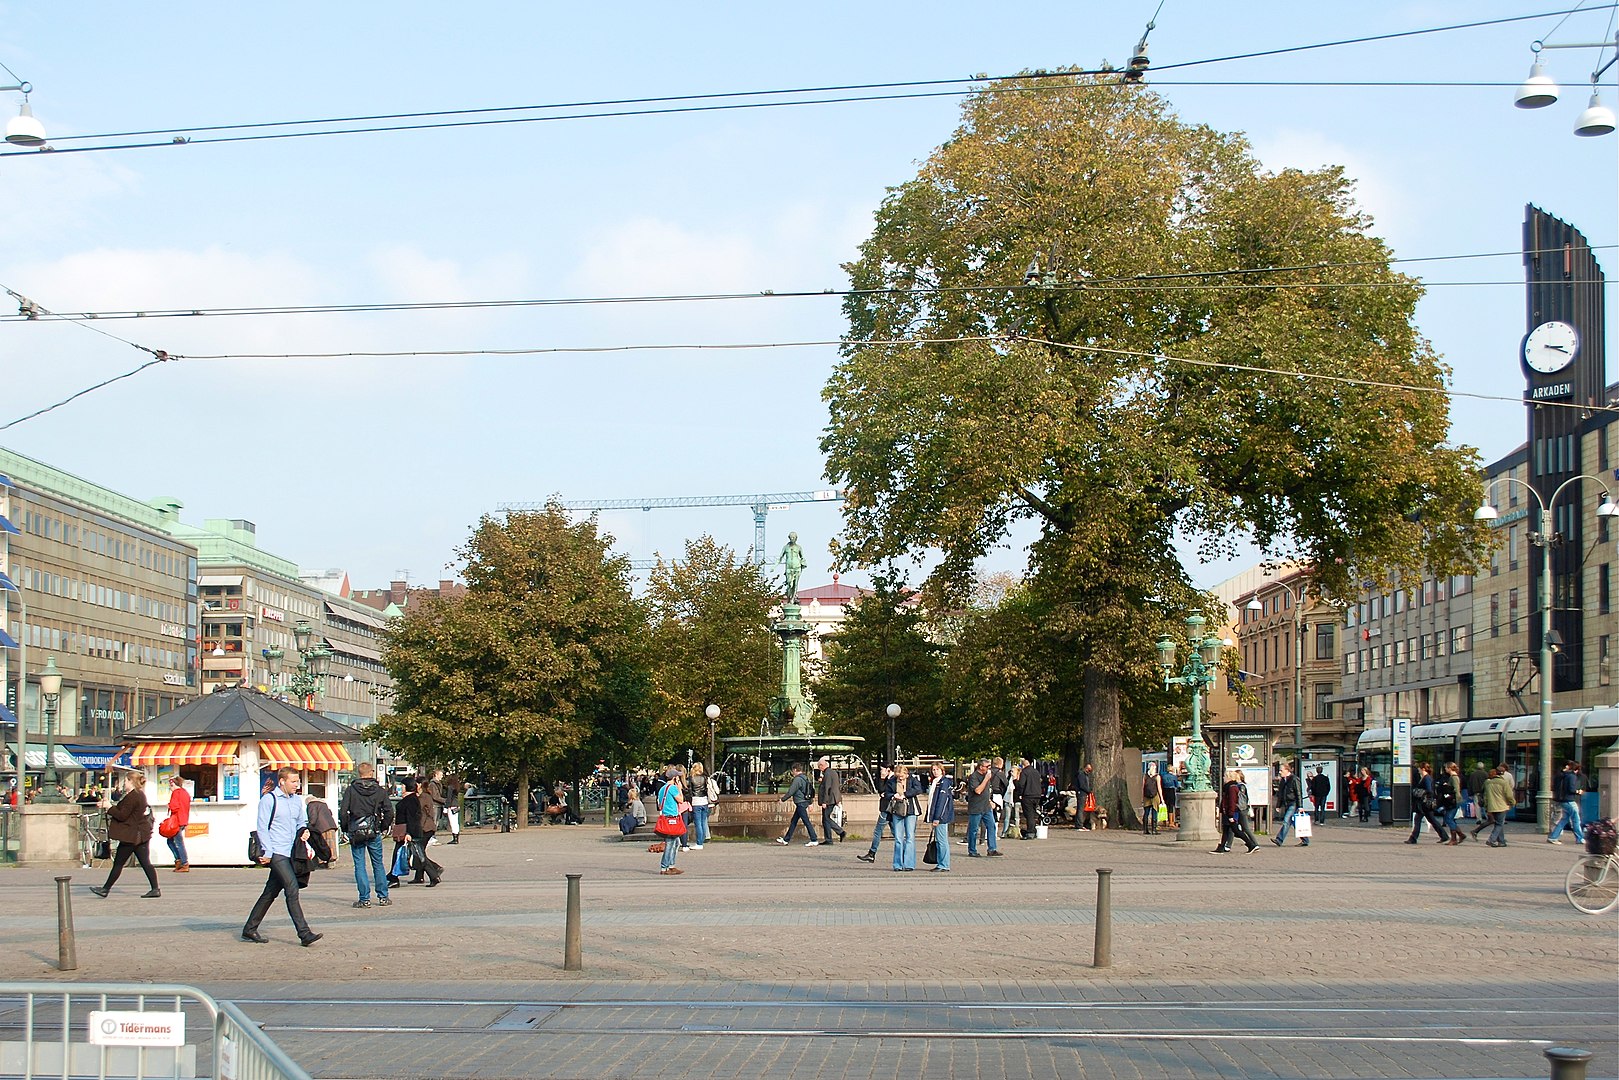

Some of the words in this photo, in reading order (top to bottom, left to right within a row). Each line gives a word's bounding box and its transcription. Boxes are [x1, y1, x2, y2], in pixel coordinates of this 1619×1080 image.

[1532, 383, 1570, 399] ARKADEN
[90, 708, 107, 719] VERO
[1399, 721, 1406, 733] E
[120, 1022, 171, 1034] Tidermans
